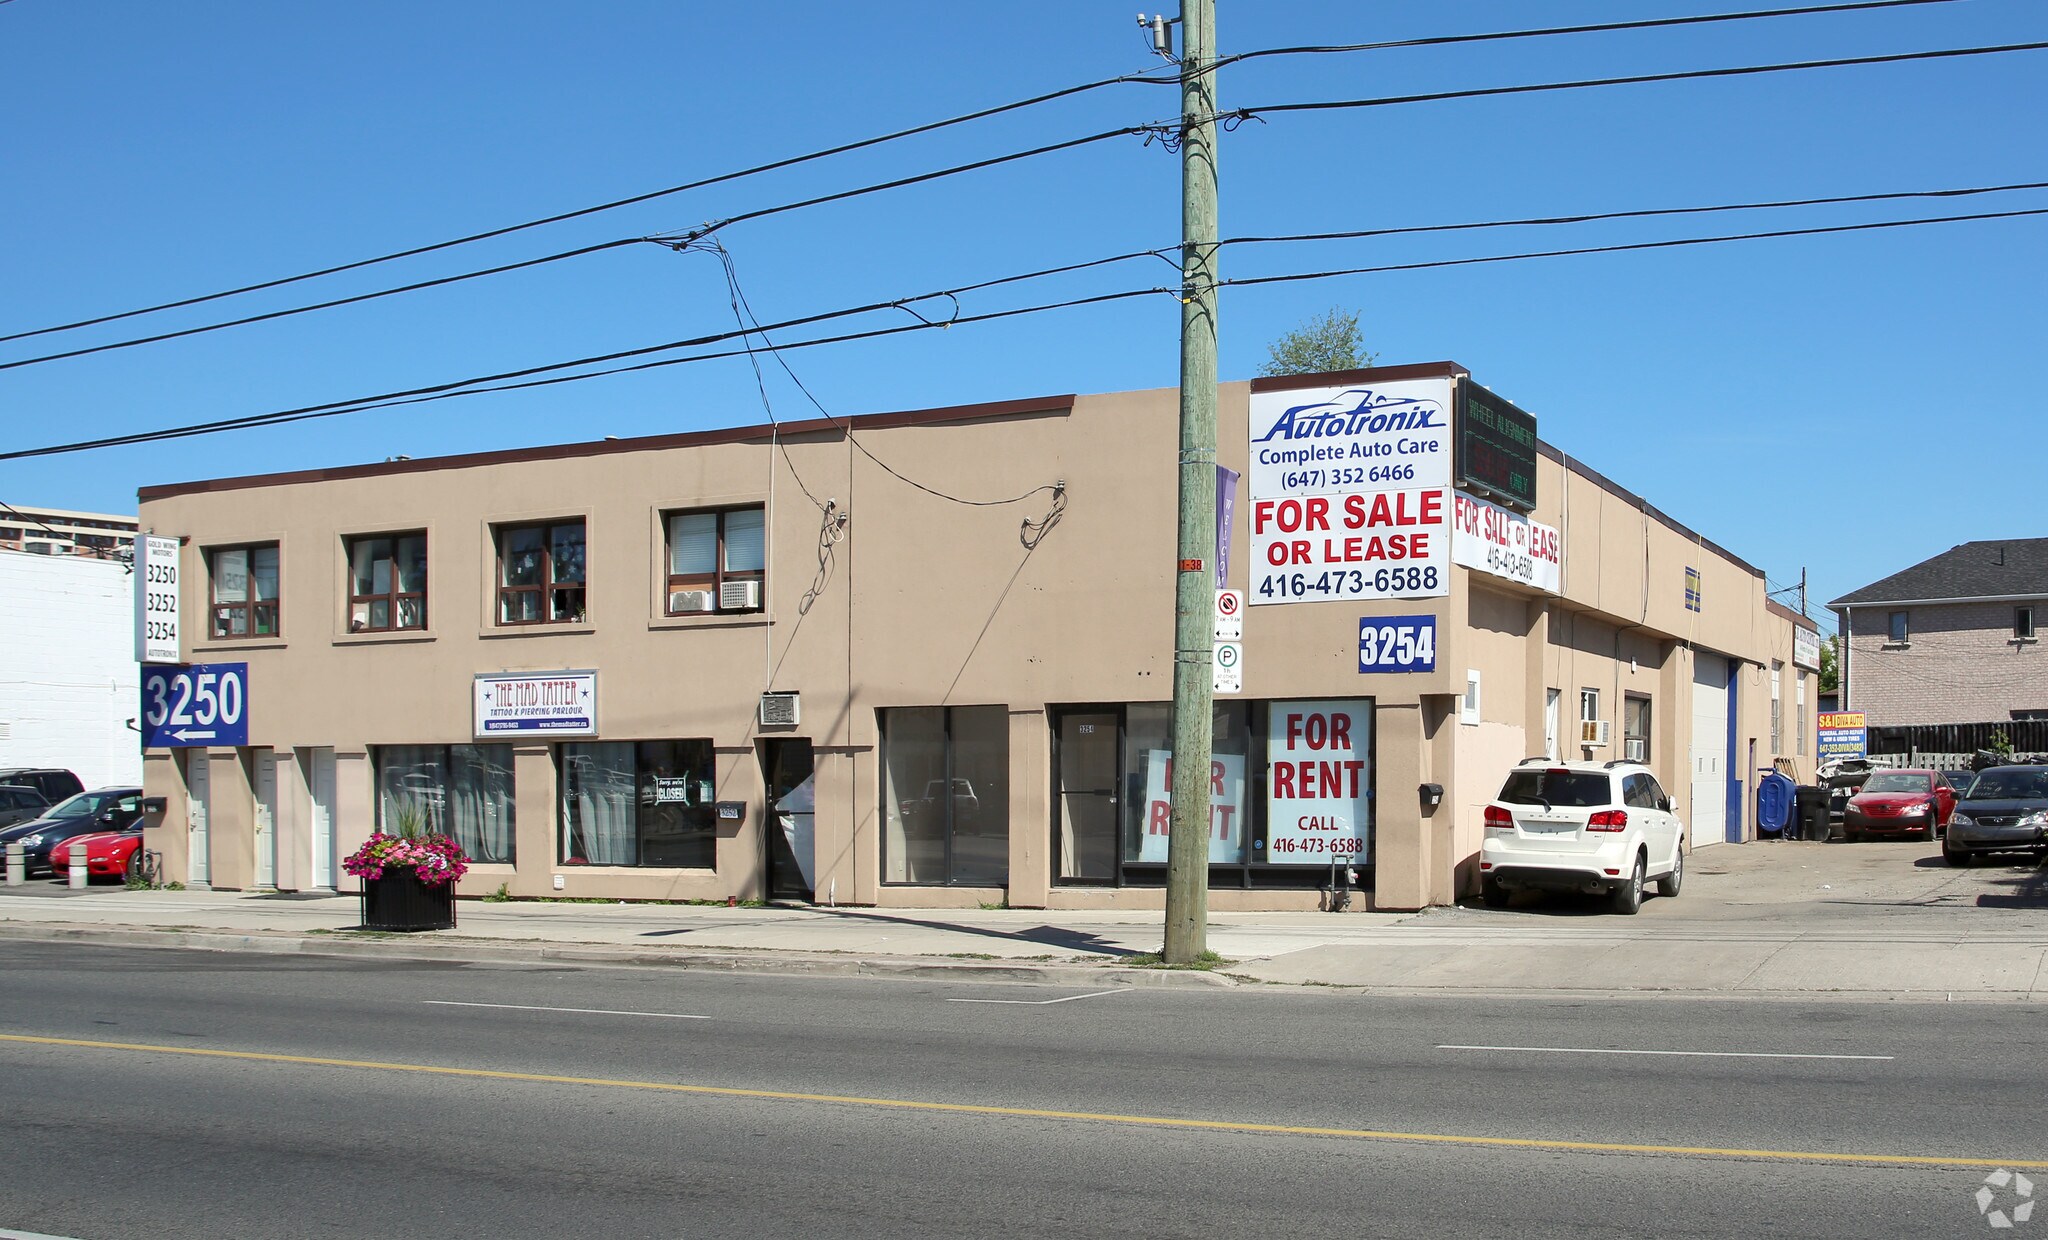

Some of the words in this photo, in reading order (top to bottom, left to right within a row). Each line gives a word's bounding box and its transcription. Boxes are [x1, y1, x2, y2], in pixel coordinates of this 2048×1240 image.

[1259, 445, 1344, 466] Complete
[1349, 442, 1392, 459] Auto
[1397, 438, 1438, 455] Care
[1281, 469, 1326, 490] (647)
[1331, 467, 1364, 486] 352
[1368, 464, 1415, 482] 6466
[1255, 497, 1330, 535] FOR
[1343, 490, 1443, 530] SALE
[1217, 499, 1232, 586] WELCOM
[1455, 496, 1479, 538] FOR
[1484, 505, 1511, 549] SALE
[1515, 525, 1526, 547] OR
[1528, 523, 1558, 565] LEASE
[1267, 540, 1312, 567] OR
[1324, 533, 1429, 563] LEASE
[147, 564, 176, 585] 3250
[1259, 565, 1438, 598] 416-473-6588
[147, 592, 176, 613] 3252
[147, 621, 176, 641] 3254
[1360, 626, 1434, 666] 3254
[146, 672, 242, 727] 3250
[495, 683, 512, 707] THE
[516, 682, 538, 707] MAD
[541, 681, 577, 706] TATTER
[490, 708, 513, 717] TATTOO
[520, 707, 550, 716] PIERCING
[552, 706, 583, 715] PARLOUR
[1850, 715, 1863, 726] AUTO
[1287, 713, 1352, 750] FOR
[1274, 760, 1365, 799] RENT
[658, 787, 684, 800] CLOSED
[720, 808, 738, 817] 3252
[1149, 800, 1236, 840] RT
[1298, 816, 1339, 831] CALL
[1273, 838, 1364, 854] 416-473-6588
